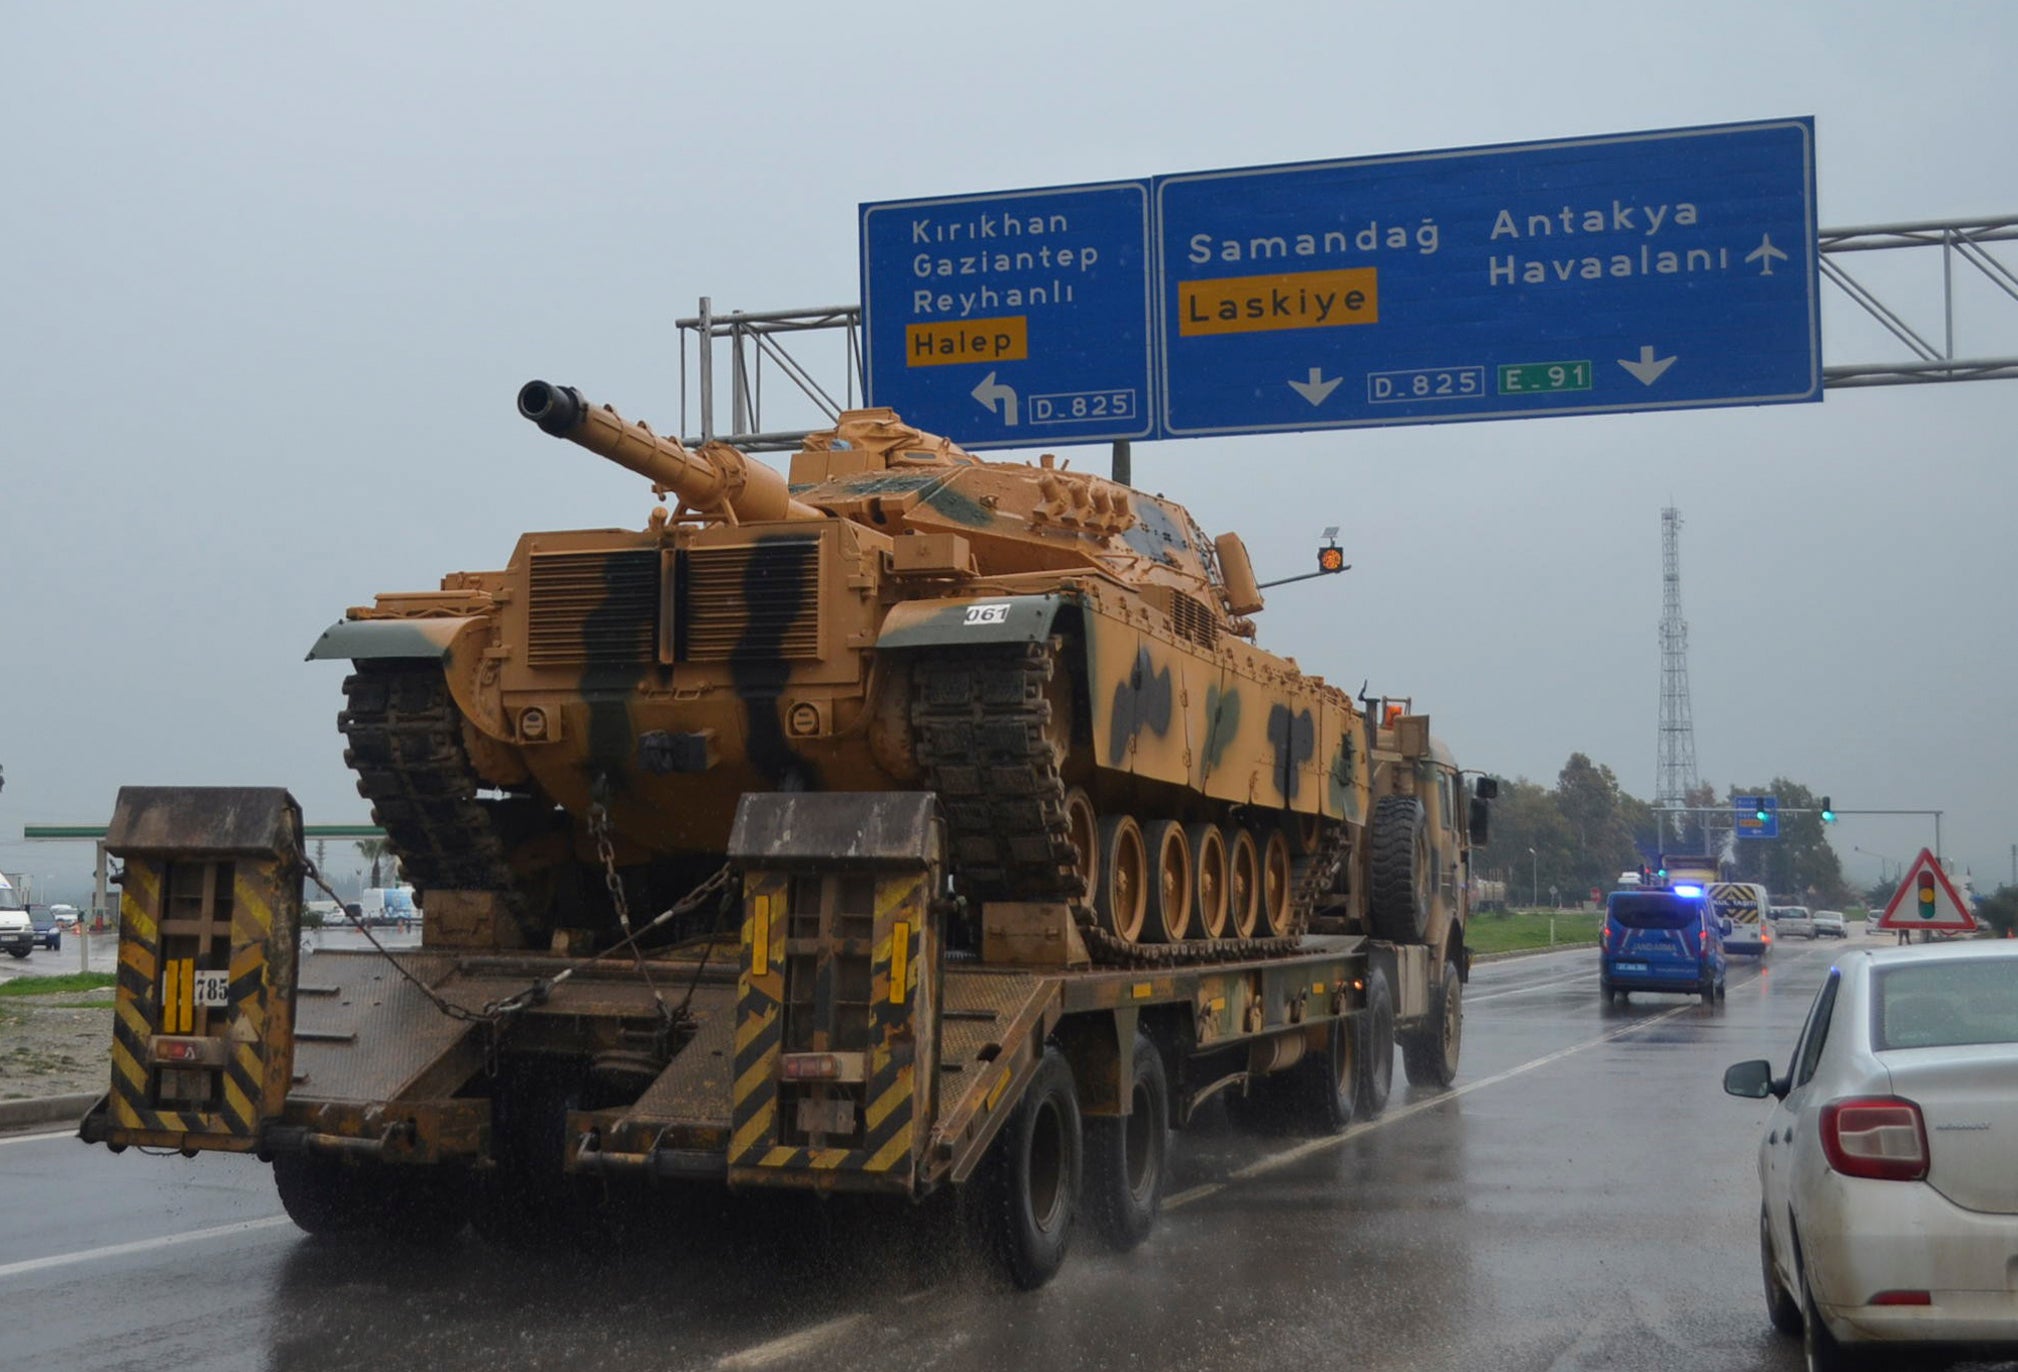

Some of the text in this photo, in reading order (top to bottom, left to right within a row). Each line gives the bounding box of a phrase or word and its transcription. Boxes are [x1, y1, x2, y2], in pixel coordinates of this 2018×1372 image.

[912, 212, 1068, 244] Kırıkhan
[1490, 199, 1698, 241] Antakya
[1188, 217, 1439, 264] Samandağ
[913, 246, 1098, 278] Gaziantep
[1489, 244, 1728, 286] Havaalanı
[913, 279, 1073, 316] Reyhanlı
[1189, 288, 1366, 323] Laskiye
[914, 330, 1011, 357] Halep
[965, 607, 1007, 621] 061
[197, 978, 229, 1001] 785
